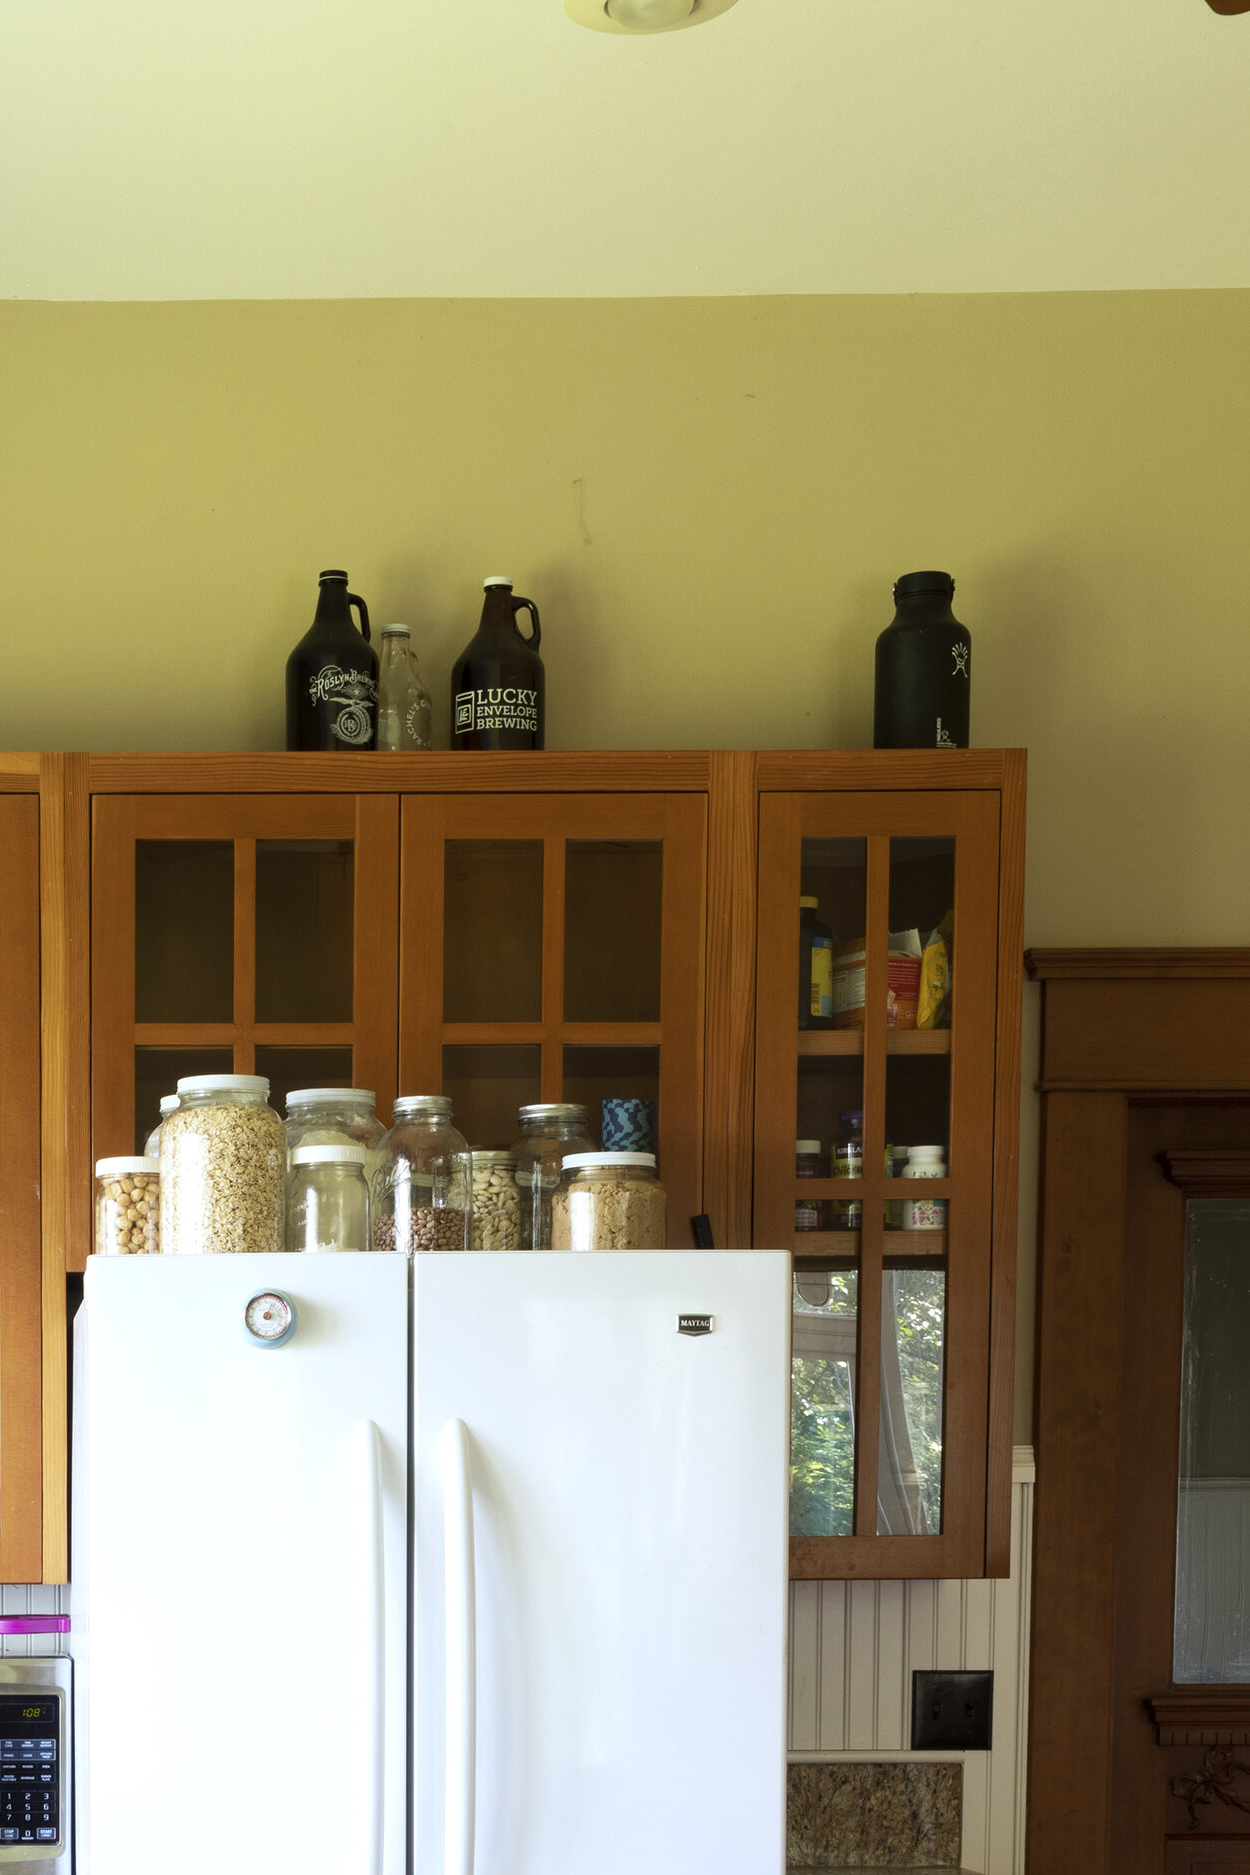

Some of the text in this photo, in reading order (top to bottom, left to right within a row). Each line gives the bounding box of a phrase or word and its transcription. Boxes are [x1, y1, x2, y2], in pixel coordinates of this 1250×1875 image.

[315, 673, 349, 701] ROSLYN
[476, 688, 537, 706] LUCKY
[476, 705, 538, 719] ENVELOPE
[406, 702, 422, 745] RACHEL'S
[476, 717, 538, 731] BREWING
